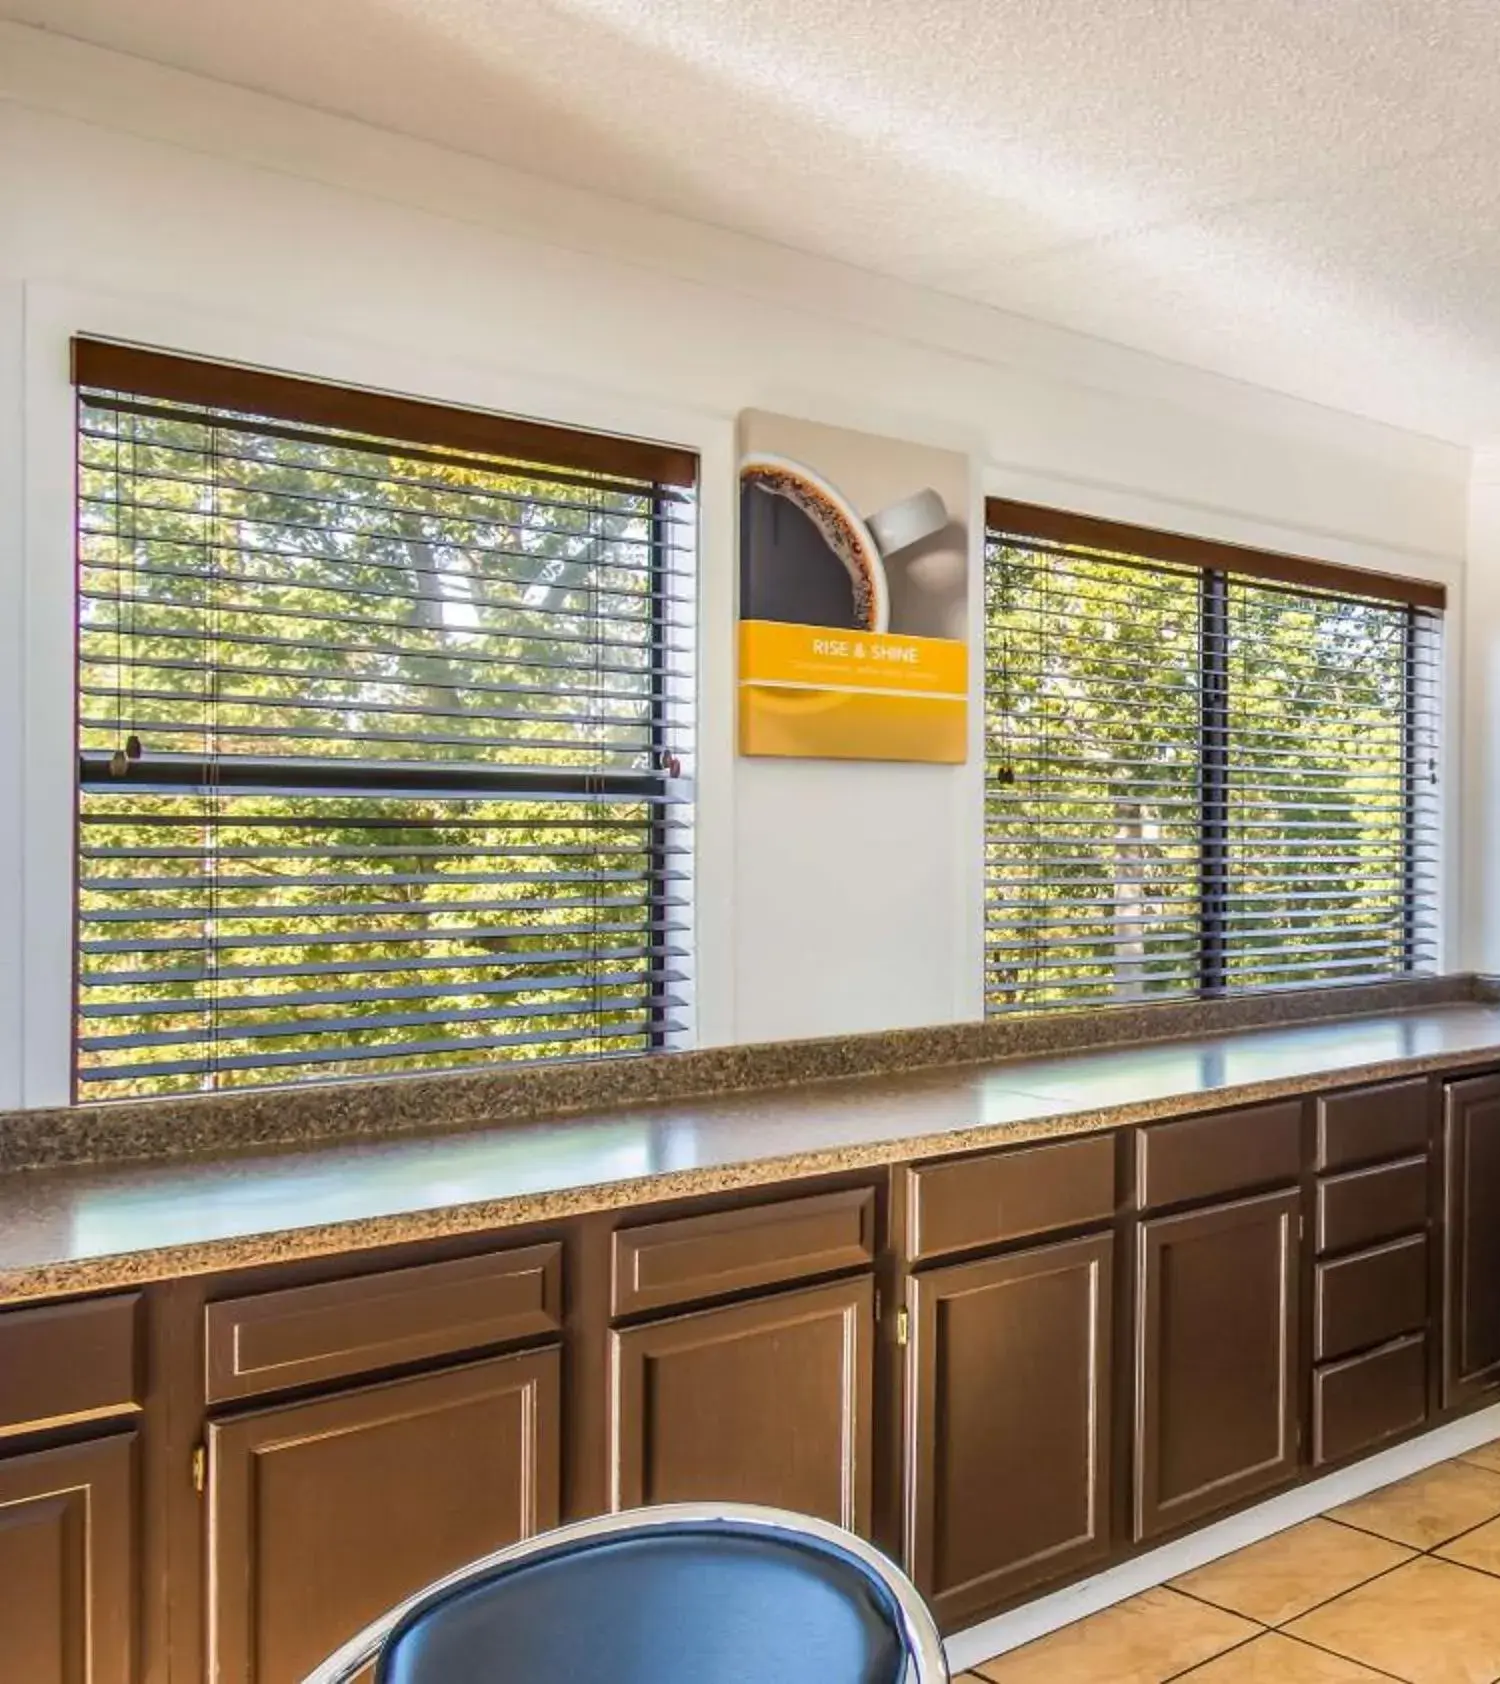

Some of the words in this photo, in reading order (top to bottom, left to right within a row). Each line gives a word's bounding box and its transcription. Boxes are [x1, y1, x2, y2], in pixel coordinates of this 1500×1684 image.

[812, 638, 850, 657] RISE
[852, 641, 867, 659] &
[871, 643, 919, 663] SHINE
